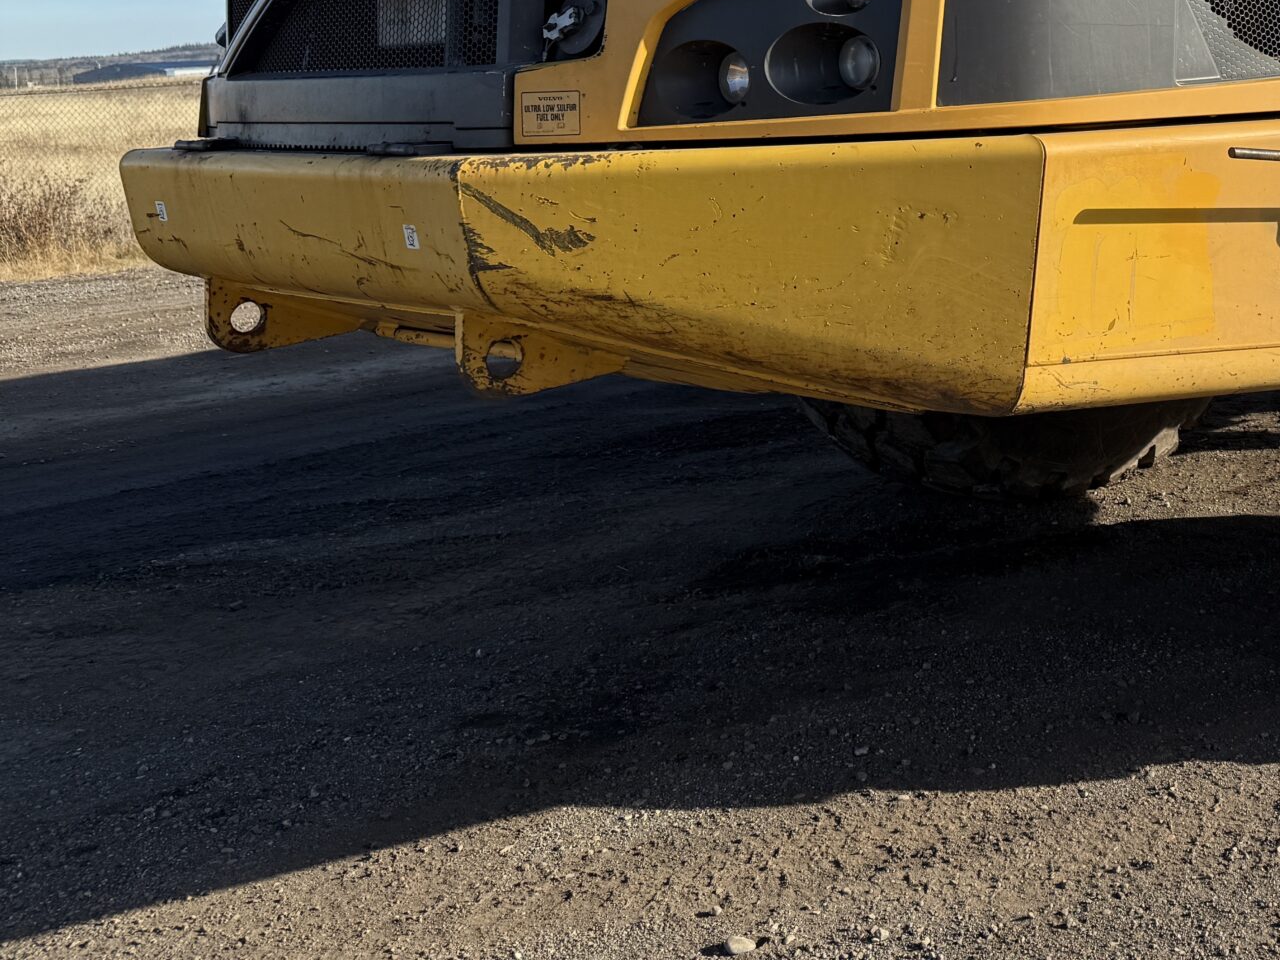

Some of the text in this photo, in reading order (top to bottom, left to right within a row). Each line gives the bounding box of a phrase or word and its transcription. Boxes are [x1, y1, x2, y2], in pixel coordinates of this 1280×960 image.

[524, 103, 577, 113] ULTRA LOW SULFUR
[536, 113, 565, 121] FUEL ONLY
